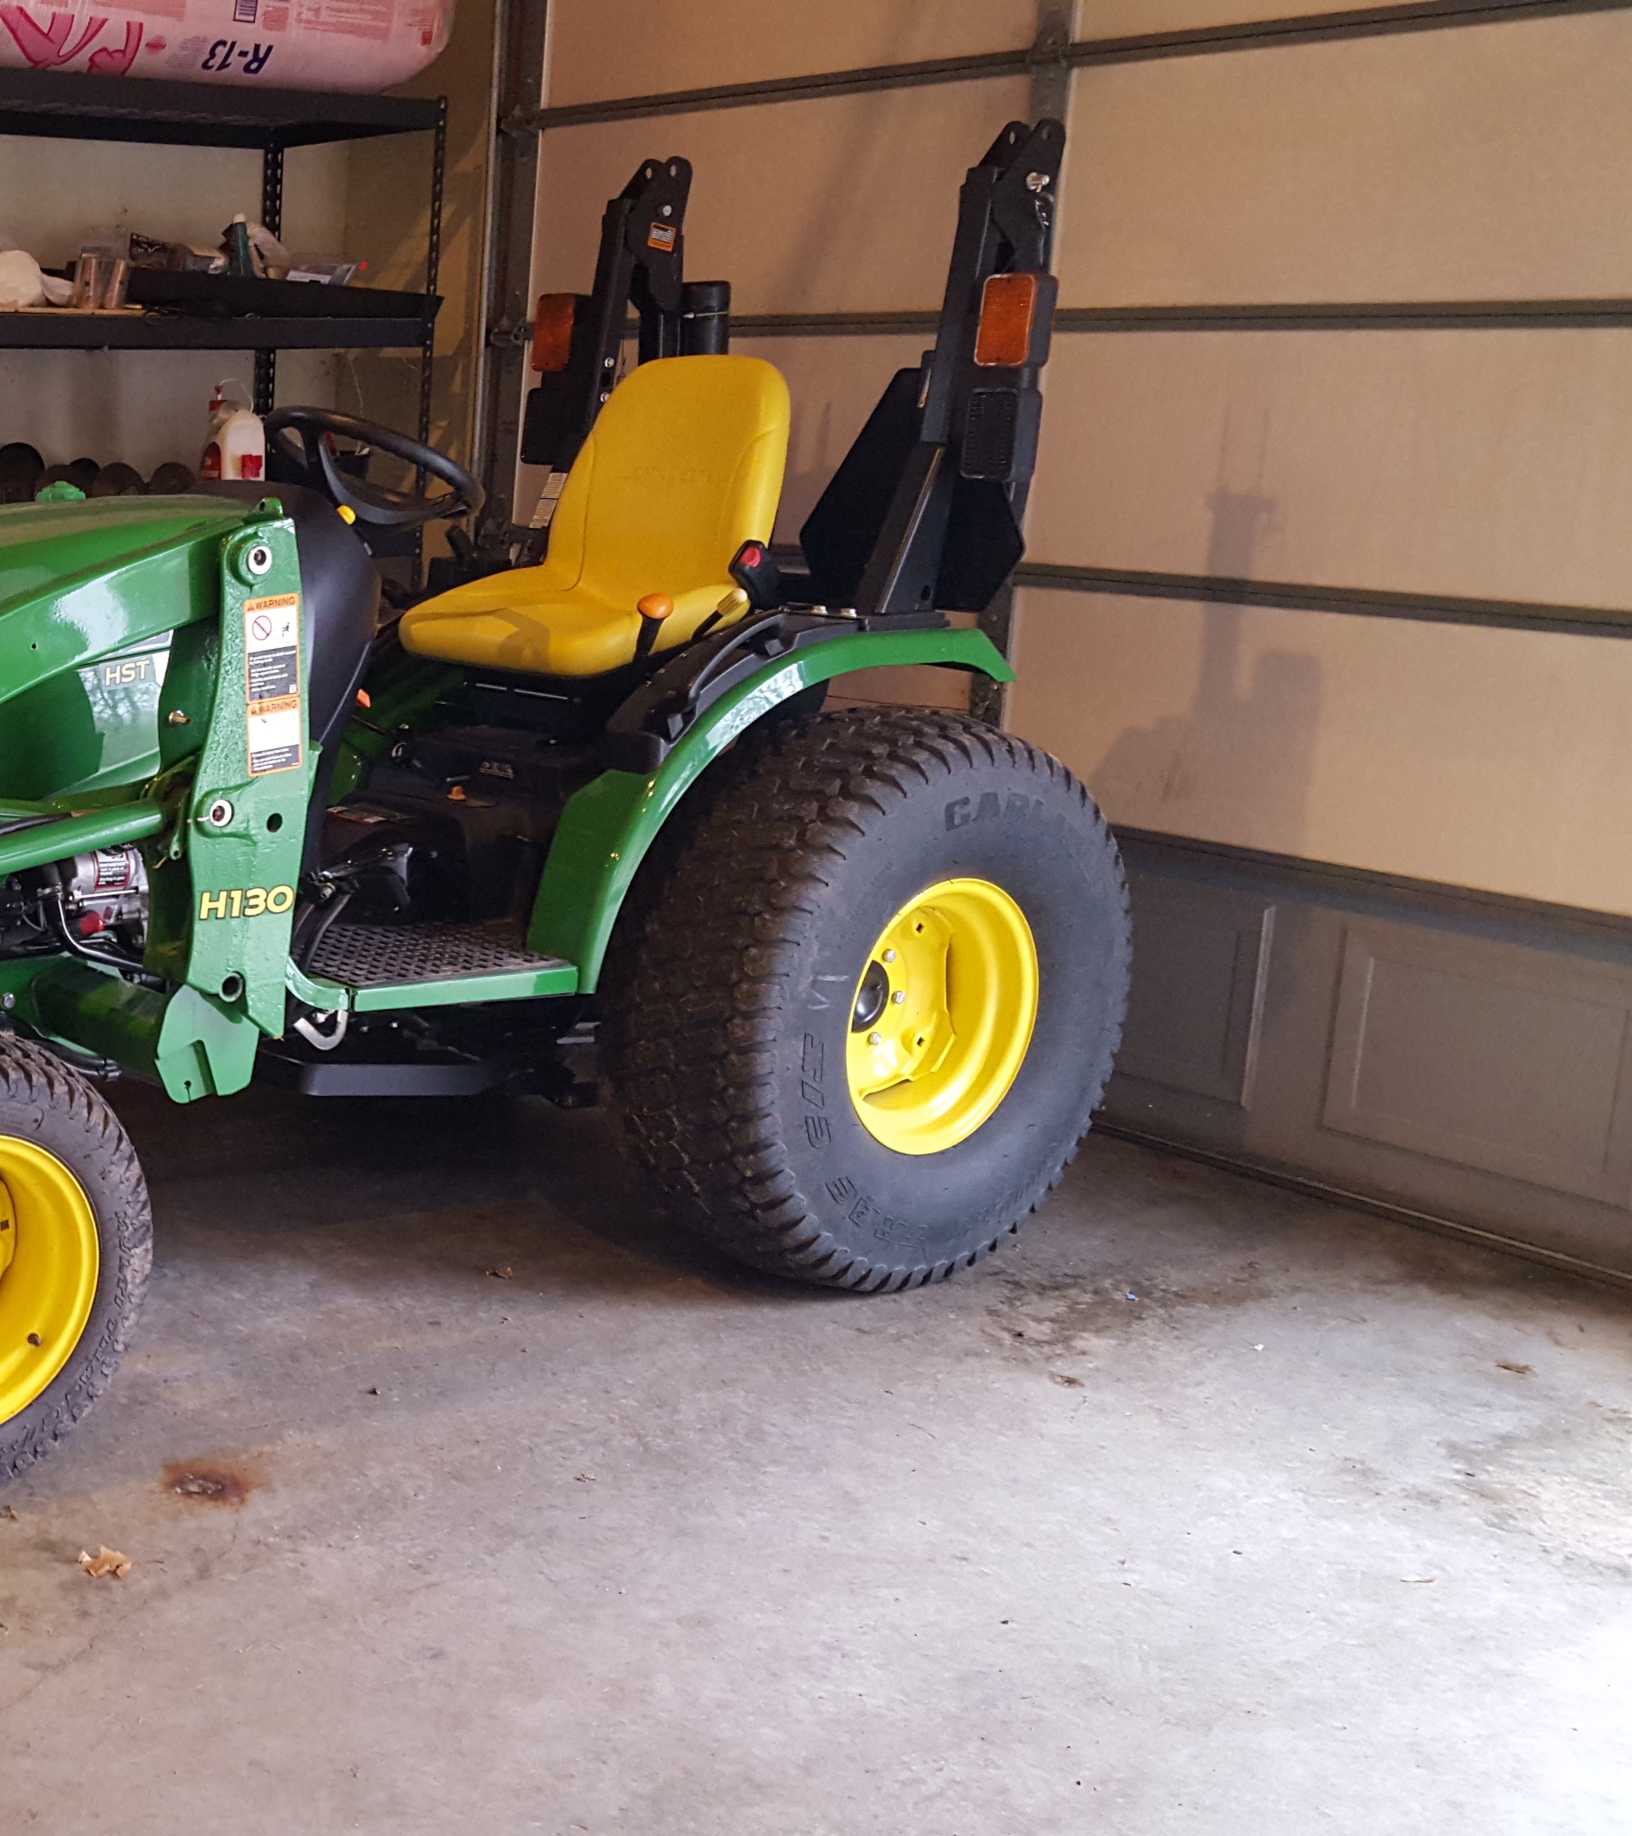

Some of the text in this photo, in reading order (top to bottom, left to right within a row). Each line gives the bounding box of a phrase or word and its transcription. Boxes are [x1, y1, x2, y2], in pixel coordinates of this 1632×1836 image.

[201, 40, 274, 75] R-13
[255, 596, 296, 610] WARNING
[104, 659, 150, 687] HST
[257, 699, 297, 715] WARNING
[198, 885, 296, 920] H130
